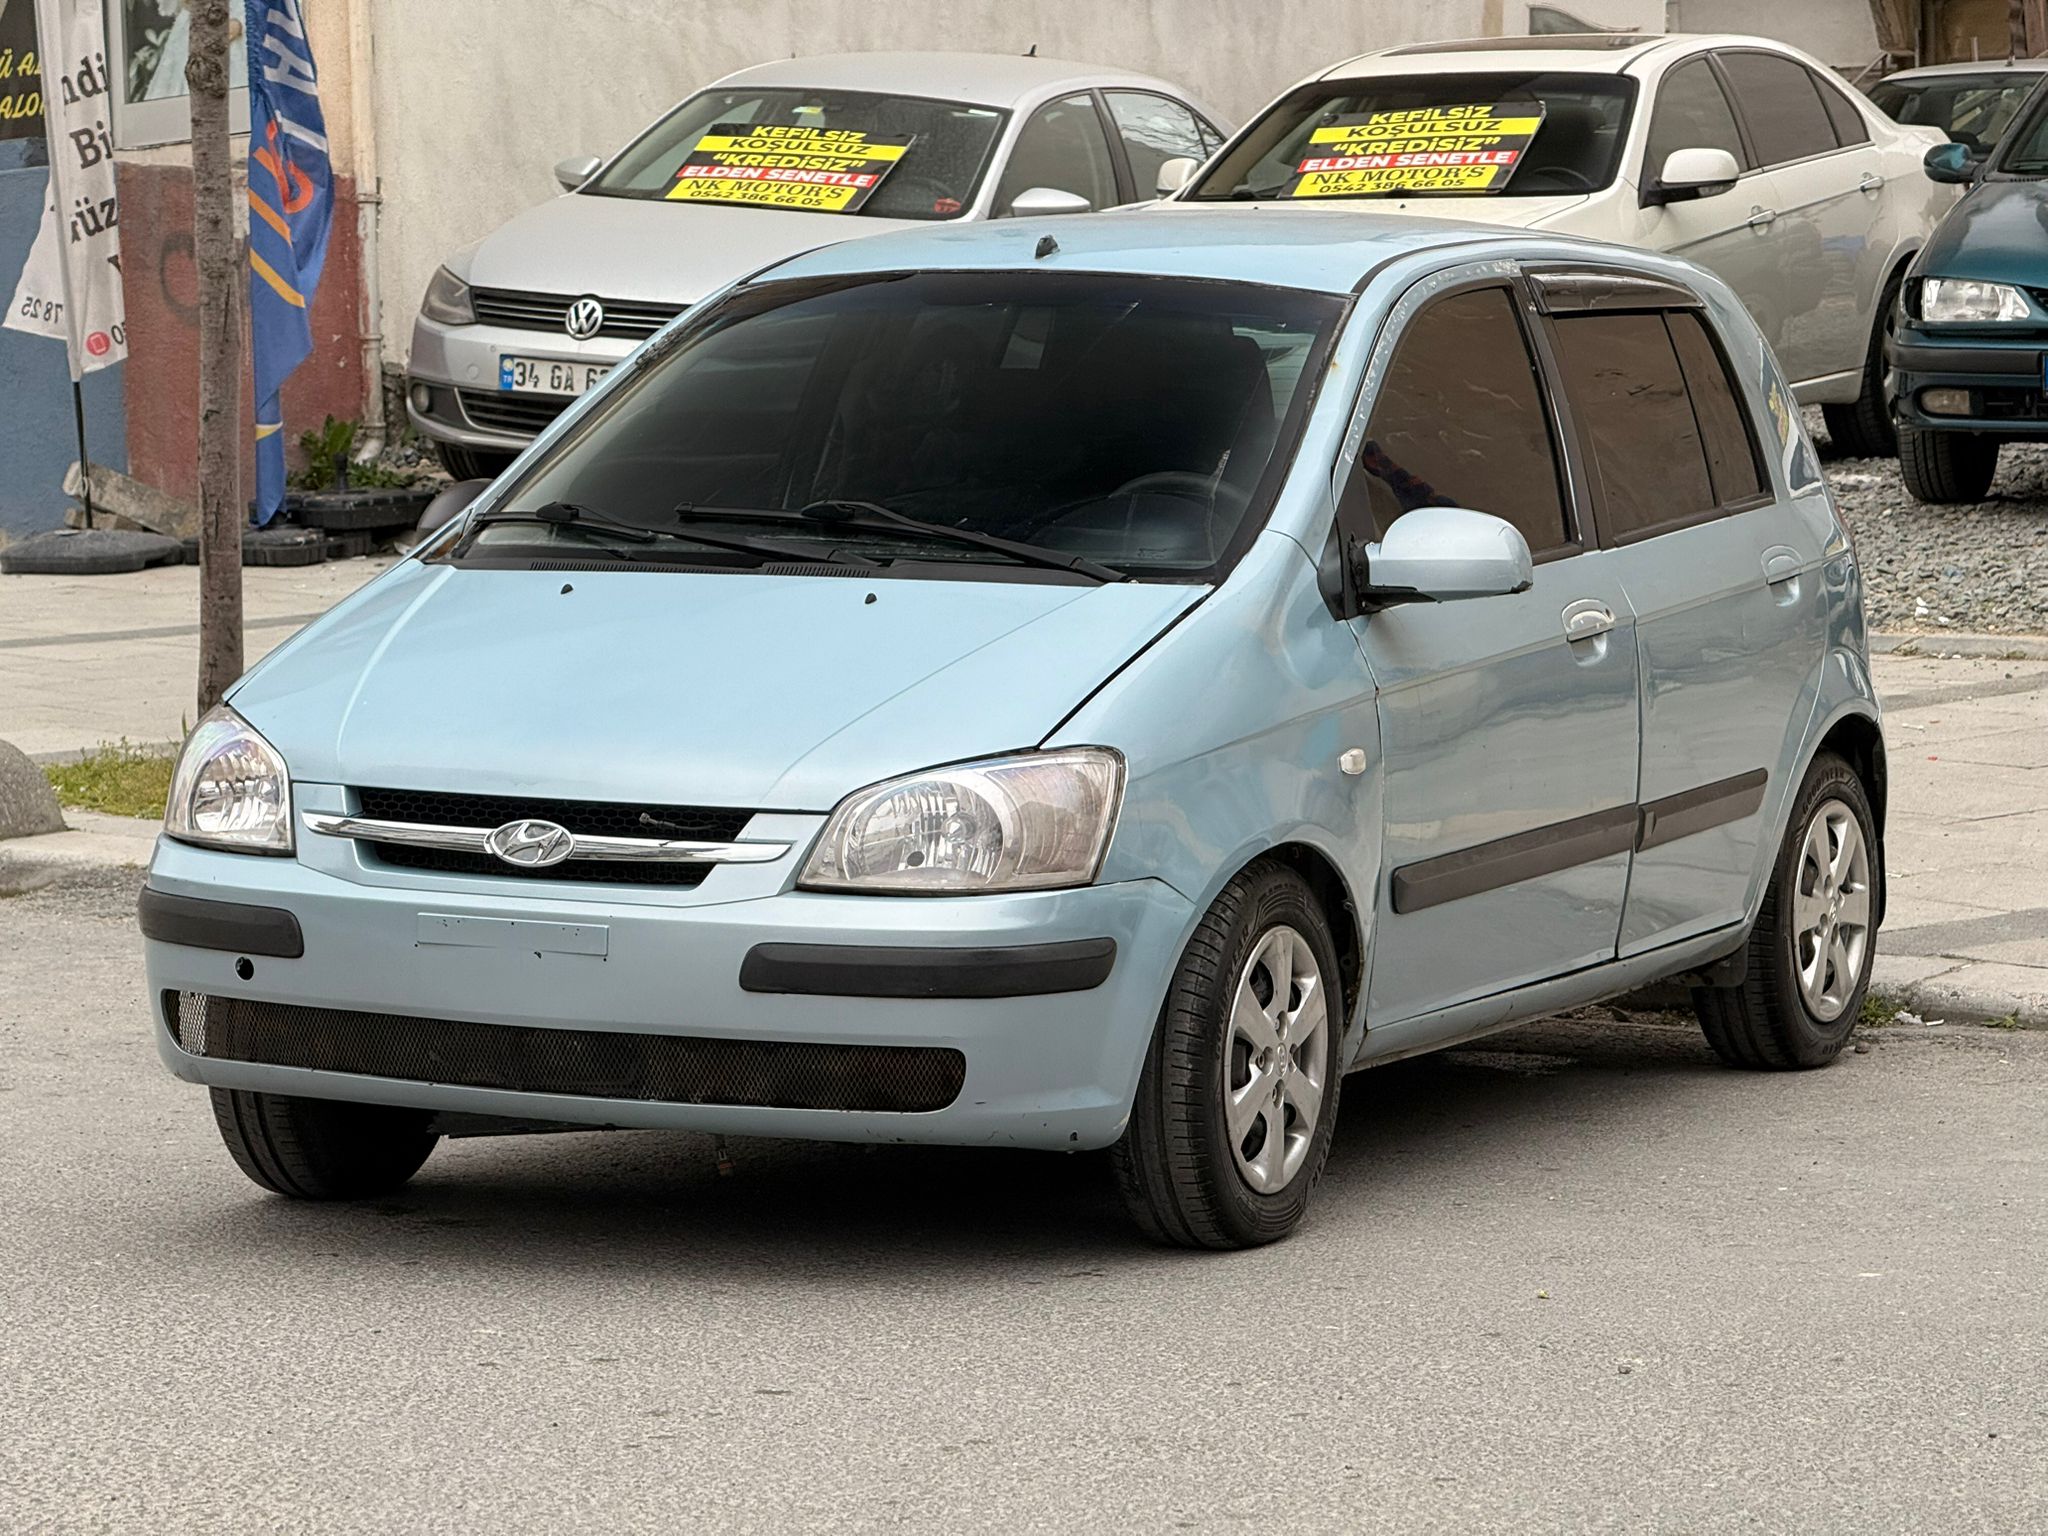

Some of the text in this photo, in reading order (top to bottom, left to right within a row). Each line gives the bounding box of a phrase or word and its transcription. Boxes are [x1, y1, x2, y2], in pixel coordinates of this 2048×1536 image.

[1346, 120, 1503, 138] KOŞULSUZ
[728, 138, 873, 155] KOŞULSUZ
[1303, 150, 1513, 172] ELDEN SENETLE
[682, 165, 873, 188] ELDEN SENETLE
[1309, 172, 1354, 185] NK
[685, 180, 726, 191] NK
[1318, 184, 1367, 194] 0542
[1411, 179, 1437, 188] 66
[1441, 179, 1466, 187] 05
[690, 191, 825, 207] 0542 386 66 05
[515, 362, 540, 388] 34
[551, 365, 575, 392] GA
